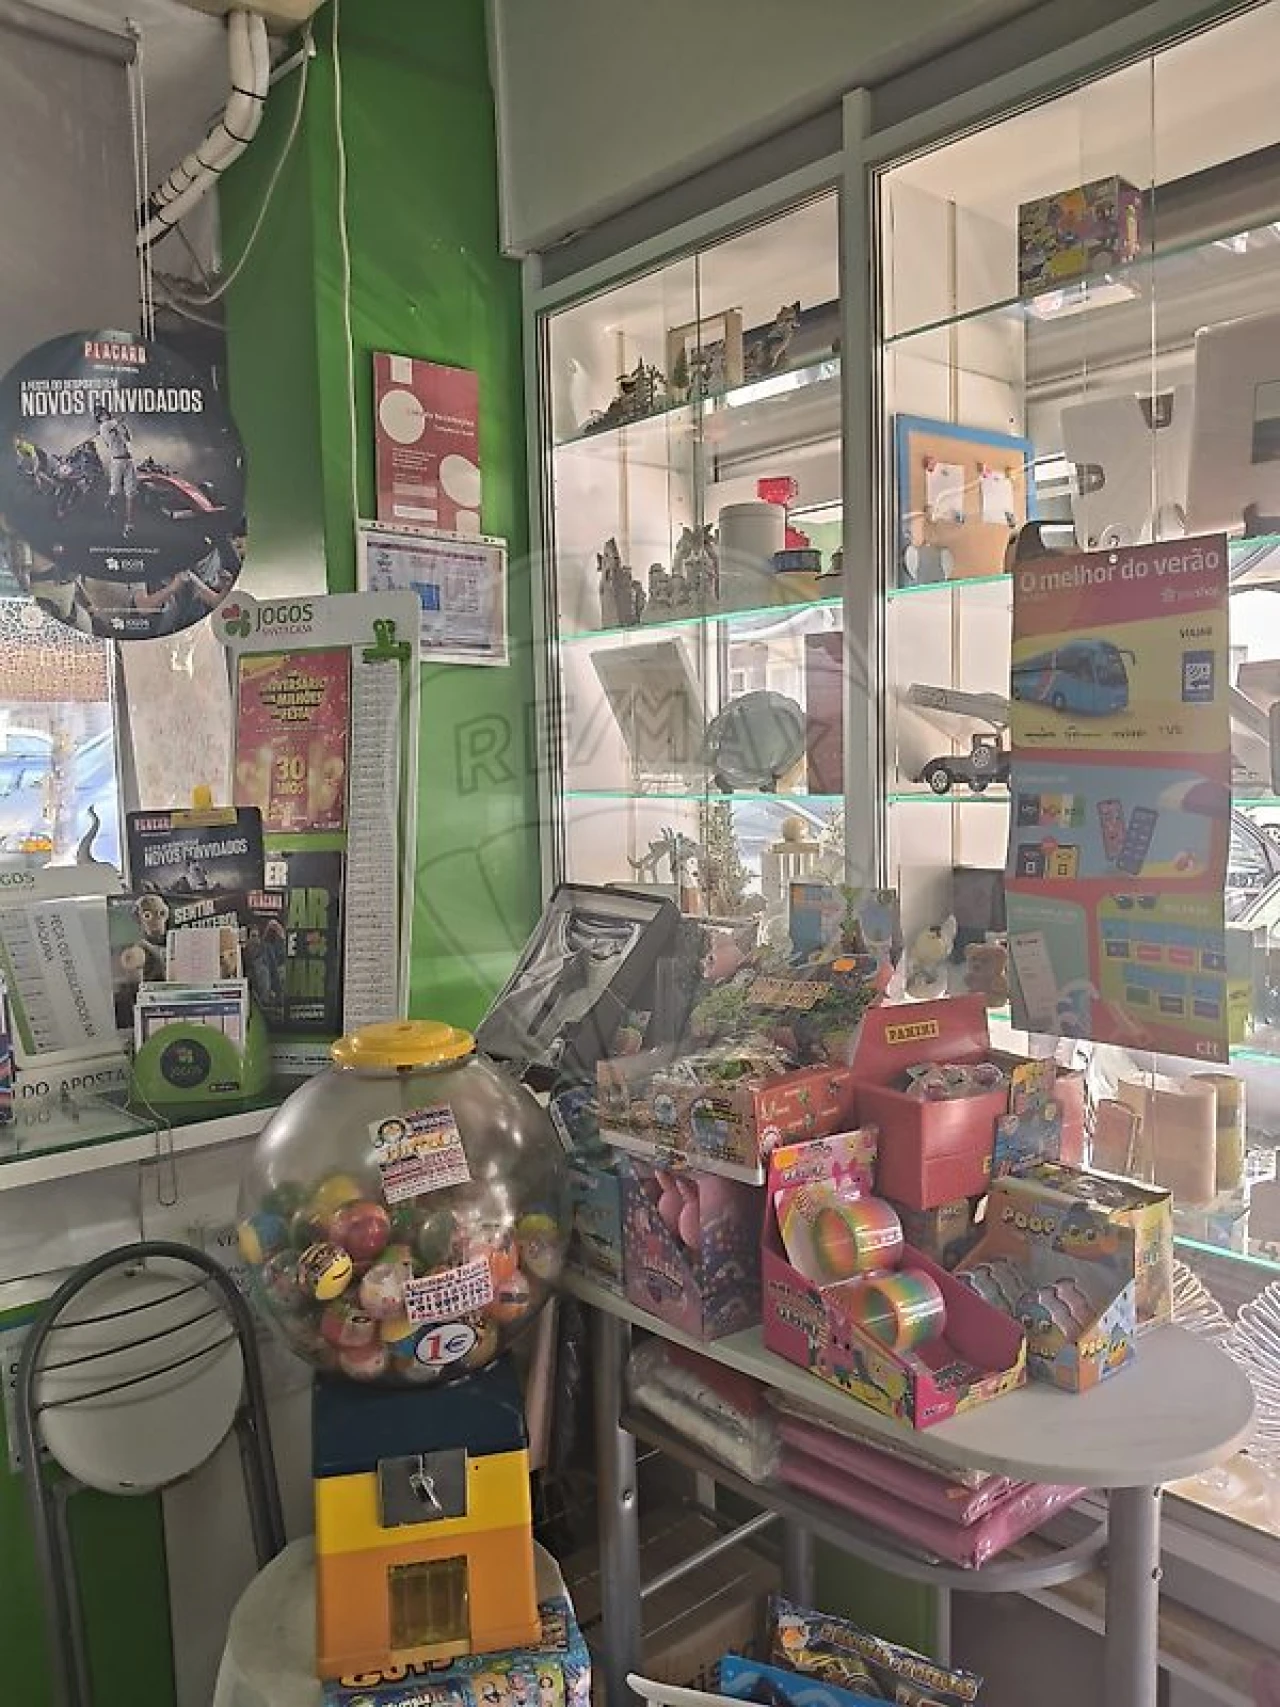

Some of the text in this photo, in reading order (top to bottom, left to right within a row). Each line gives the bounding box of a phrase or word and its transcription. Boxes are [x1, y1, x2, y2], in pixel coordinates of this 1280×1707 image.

[84, 341, 147, 363] PLACARD
[21, 387, 203, 417] NOVOS CONVIDADOS
[1020, 548, 1220, 593] O melhor do verão
[256, 603, 314, 633] JOGOS
[888, 1024, 937, 1042] PANINI
